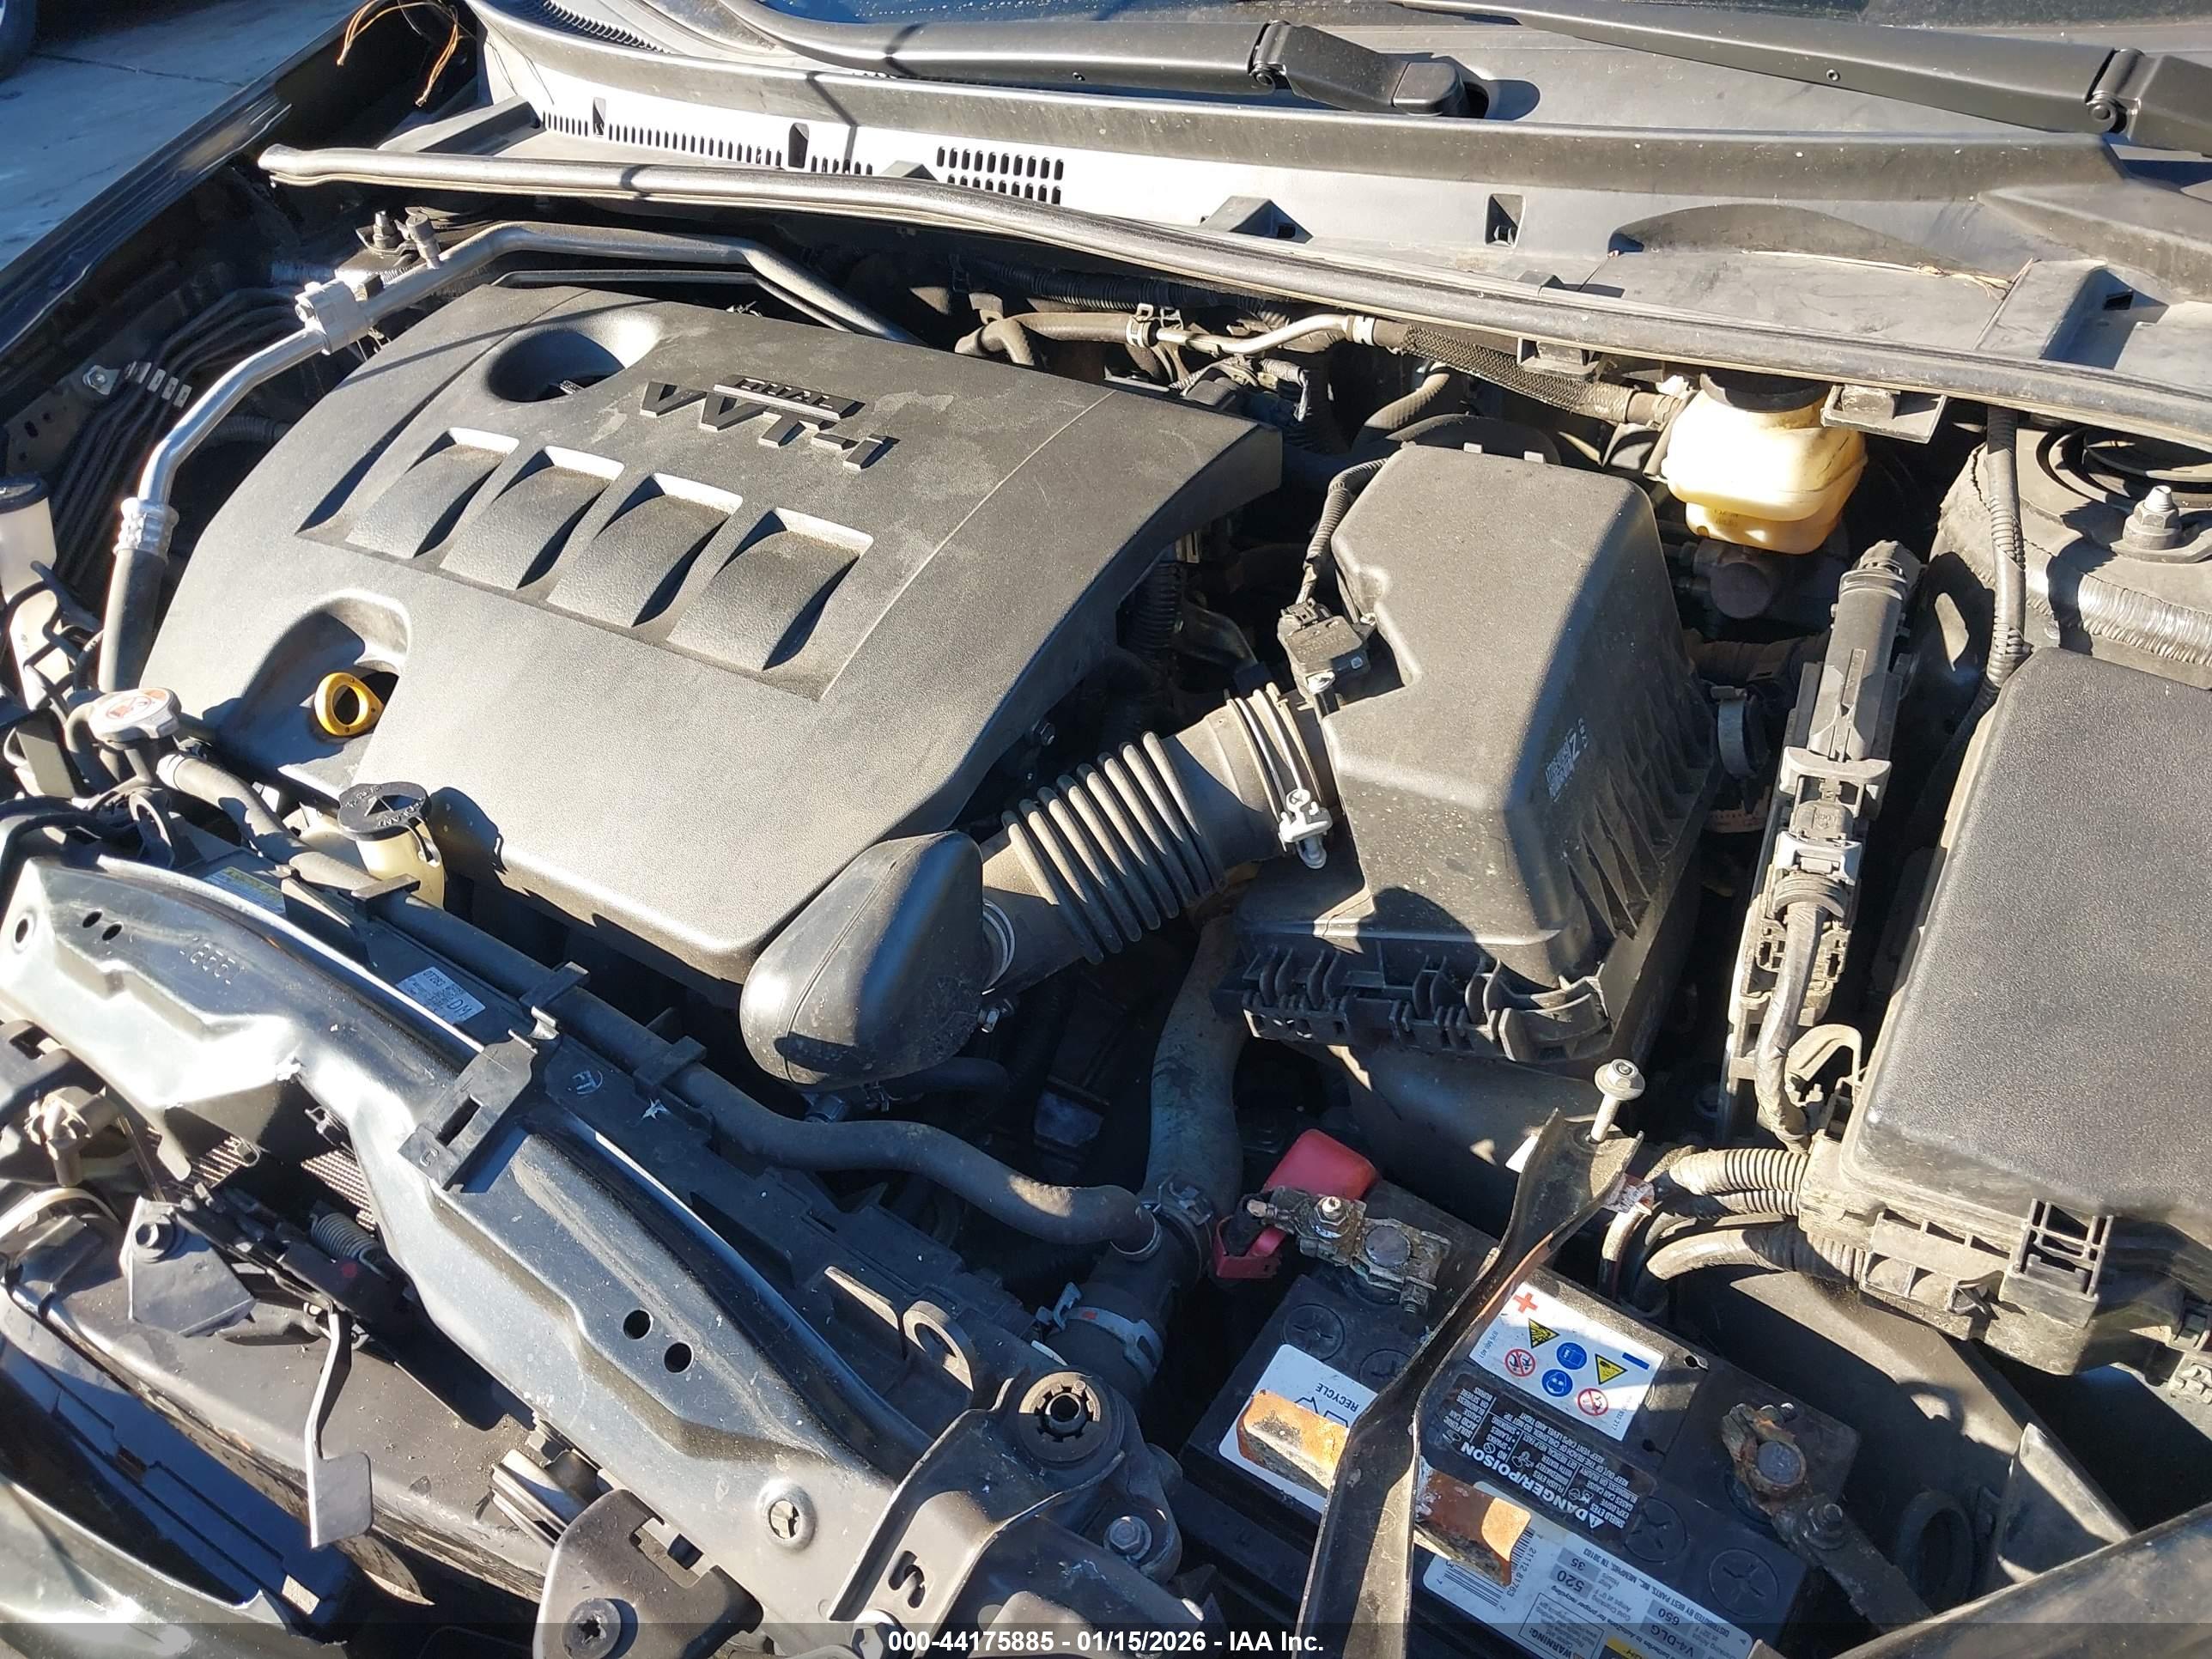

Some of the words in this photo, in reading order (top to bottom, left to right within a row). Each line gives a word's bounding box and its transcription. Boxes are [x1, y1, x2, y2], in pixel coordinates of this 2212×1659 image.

[735, 377, 835, 410] DUAL
[1315, 1382, 1358, 1412] RECYCLE
[1460, 1388, 1480, 1402] SEVERE
[1473, 1386, 1492, 1401] BURNS
[1455, 1395, 1486, 1414] BLINDNESS
[1480, 1399, 1489, 1407] OR
[1449, 1409, 1462, 1420] CAN
[1462, 1408, 1481, 1422] CAUSE
[1519, 1412, 1535, 1425] TIGHT
[1442, 1415, 1474, 1437] SULFURIC
[1460, 1416, 1477, 1430] ACID
[1491, 1416, 1516, 1433] SMOKING
[1512, 1417, 1524, 1427] NOT
[1522, 1423, 1532, 1432] DO
[1534, 1419, 1547, 1431] AND
[1490, 1425, 1512, 1442] FLAMES
[1545, 1425, 1562, 1439] LEVEL
[1486, 1433, 1508, 1449] SPARKS
[1534, 1440, 1547, 1451] HELP
[1559, 1443, 1567, 1451] OF
[1561, 1436, 1577, 1448] CAPS
[1496, 1449, 1507, 1460] NO
[1547, 1448, 1566, 1462] MEDICAL
[1565, 1447, 1586, 1462] REACH
[1576, 1443, 1590, 1455] VENT
[1565, 1458, 1577, 1468] GET
[1584, 1457, 1595, 1468] THE
[1589, 1451, 1604, 1463] KEEP
[1534, 1462, 1569, 1485] IMMEDIATELY
[1558, 1464, 1572, 1477] WITH
[1595, 1463, 1604, 1472] OF
[1458, 1440, 1590, 1520] DANGER/POISON
[1532, 1470, 1547, 1482] EYES
[1613, 1474, 1629, 1486] KEEP
[1546, 1478, 1565, 1492] FLUSH
[1585, 1480, 1604, 1493] CAUSE
[1603, 1490, 1615, 1500] CAN
[1607, 1482, 1638, 1504] BLINDNESS
[1589, 1503, 1605, 1516] EYES
[1599, 1498, 1629, 1519] EXPLOSIVE
[1614, 1496, 1633, 1510] GASES
[1603, 1510, 1626, 1528] SHIELD
[1519, 1547, 1536, 1571] 21112
[1570, 1557, 1586, 1571] 35
[1600, 1558, 1609, 1566] TN
[1506, 1571, 1523, 1597] 81763
[1555, 1569, 1585, 1592] 520
[1549, 1584, 1577, 1603] recycling
[1577, 1601, 1596, 1614] proper
[1670, 1598, 1686, 1611] BEST
[1685, 1607, 1694, 1616] BY
[1616, 1610, 1631, 1621] Cold
[1656, 1607, 1680, 1626] 650
[1606, 1619, 1636, 1638] AutoZone
[1692, 1612, 1730, 1638] DISTRIBUTED
[1527, 1627, 1573, 1658] WARNING:
[1648, 1624, 1696, 1656] V4-DLG
[1642, 1640, 1670, 1658] batteries
